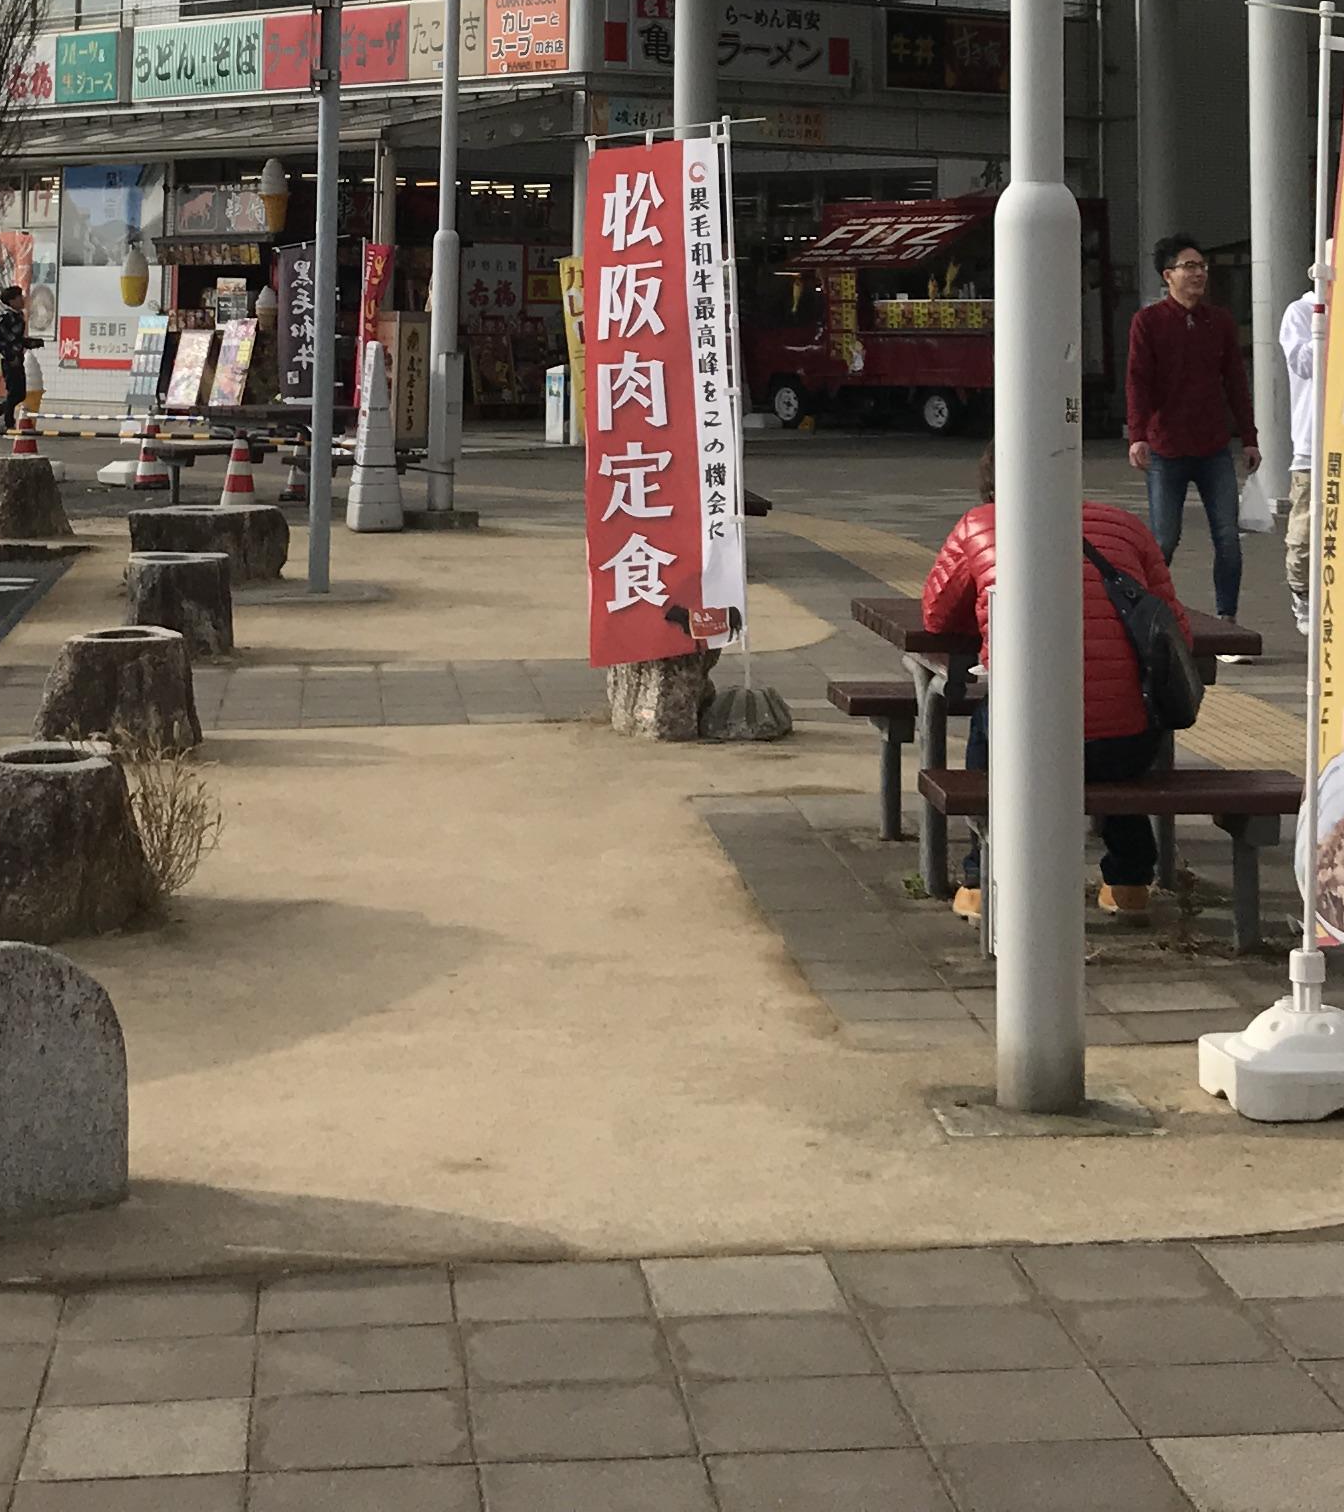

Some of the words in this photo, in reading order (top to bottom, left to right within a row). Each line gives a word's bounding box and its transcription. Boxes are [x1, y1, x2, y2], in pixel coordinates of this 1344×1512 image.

[412, 12, 480, 54] たこき
[503, 11, 560, 34] カレーと
[639, 23, 822, 70] 亀ラーメン
[890, 32, 935, 66] 牛丼
[814, 221, 966, 248] FITZ
[597, 170, 678, 613] 松阪肉定食
